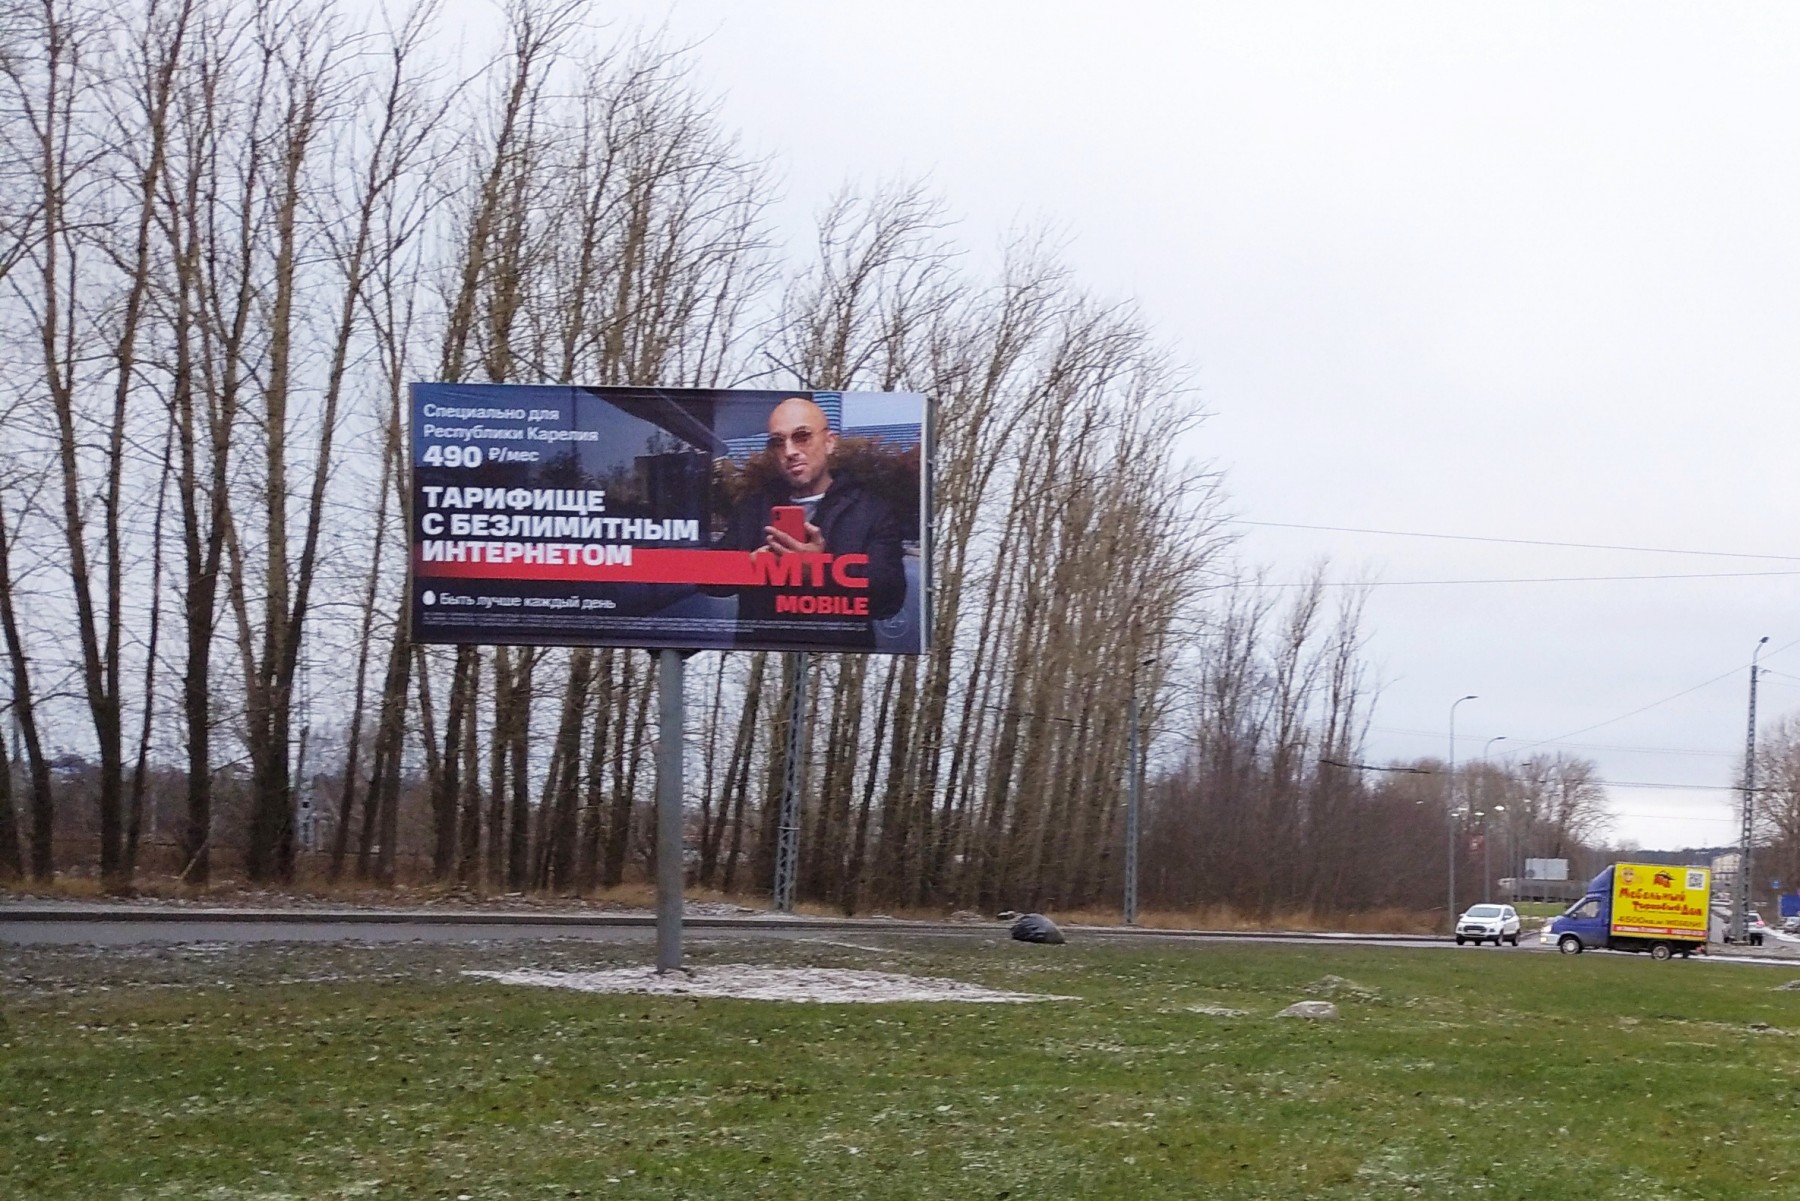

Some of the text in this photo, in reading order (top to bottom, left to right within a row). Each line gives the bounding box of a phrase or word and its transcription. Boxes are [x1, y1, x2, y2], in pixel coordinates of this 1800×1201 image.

[423, 403, 560, 422] Специально для
[423, 424, 599, 443] Республики Карелия
[422, 445, 483, 468] 490
[422, 486, 606, 514] ТАРИФИЩЕ
[422, 514, 699, 541] С БЕЗЛИМИТНЫМ
[422, 540, 633, 566] ИНТЕРНЕТОМ
[439, 592, 617, 610] Быть лучше каждый день
[776, 595, 869, 615] MOBILE
